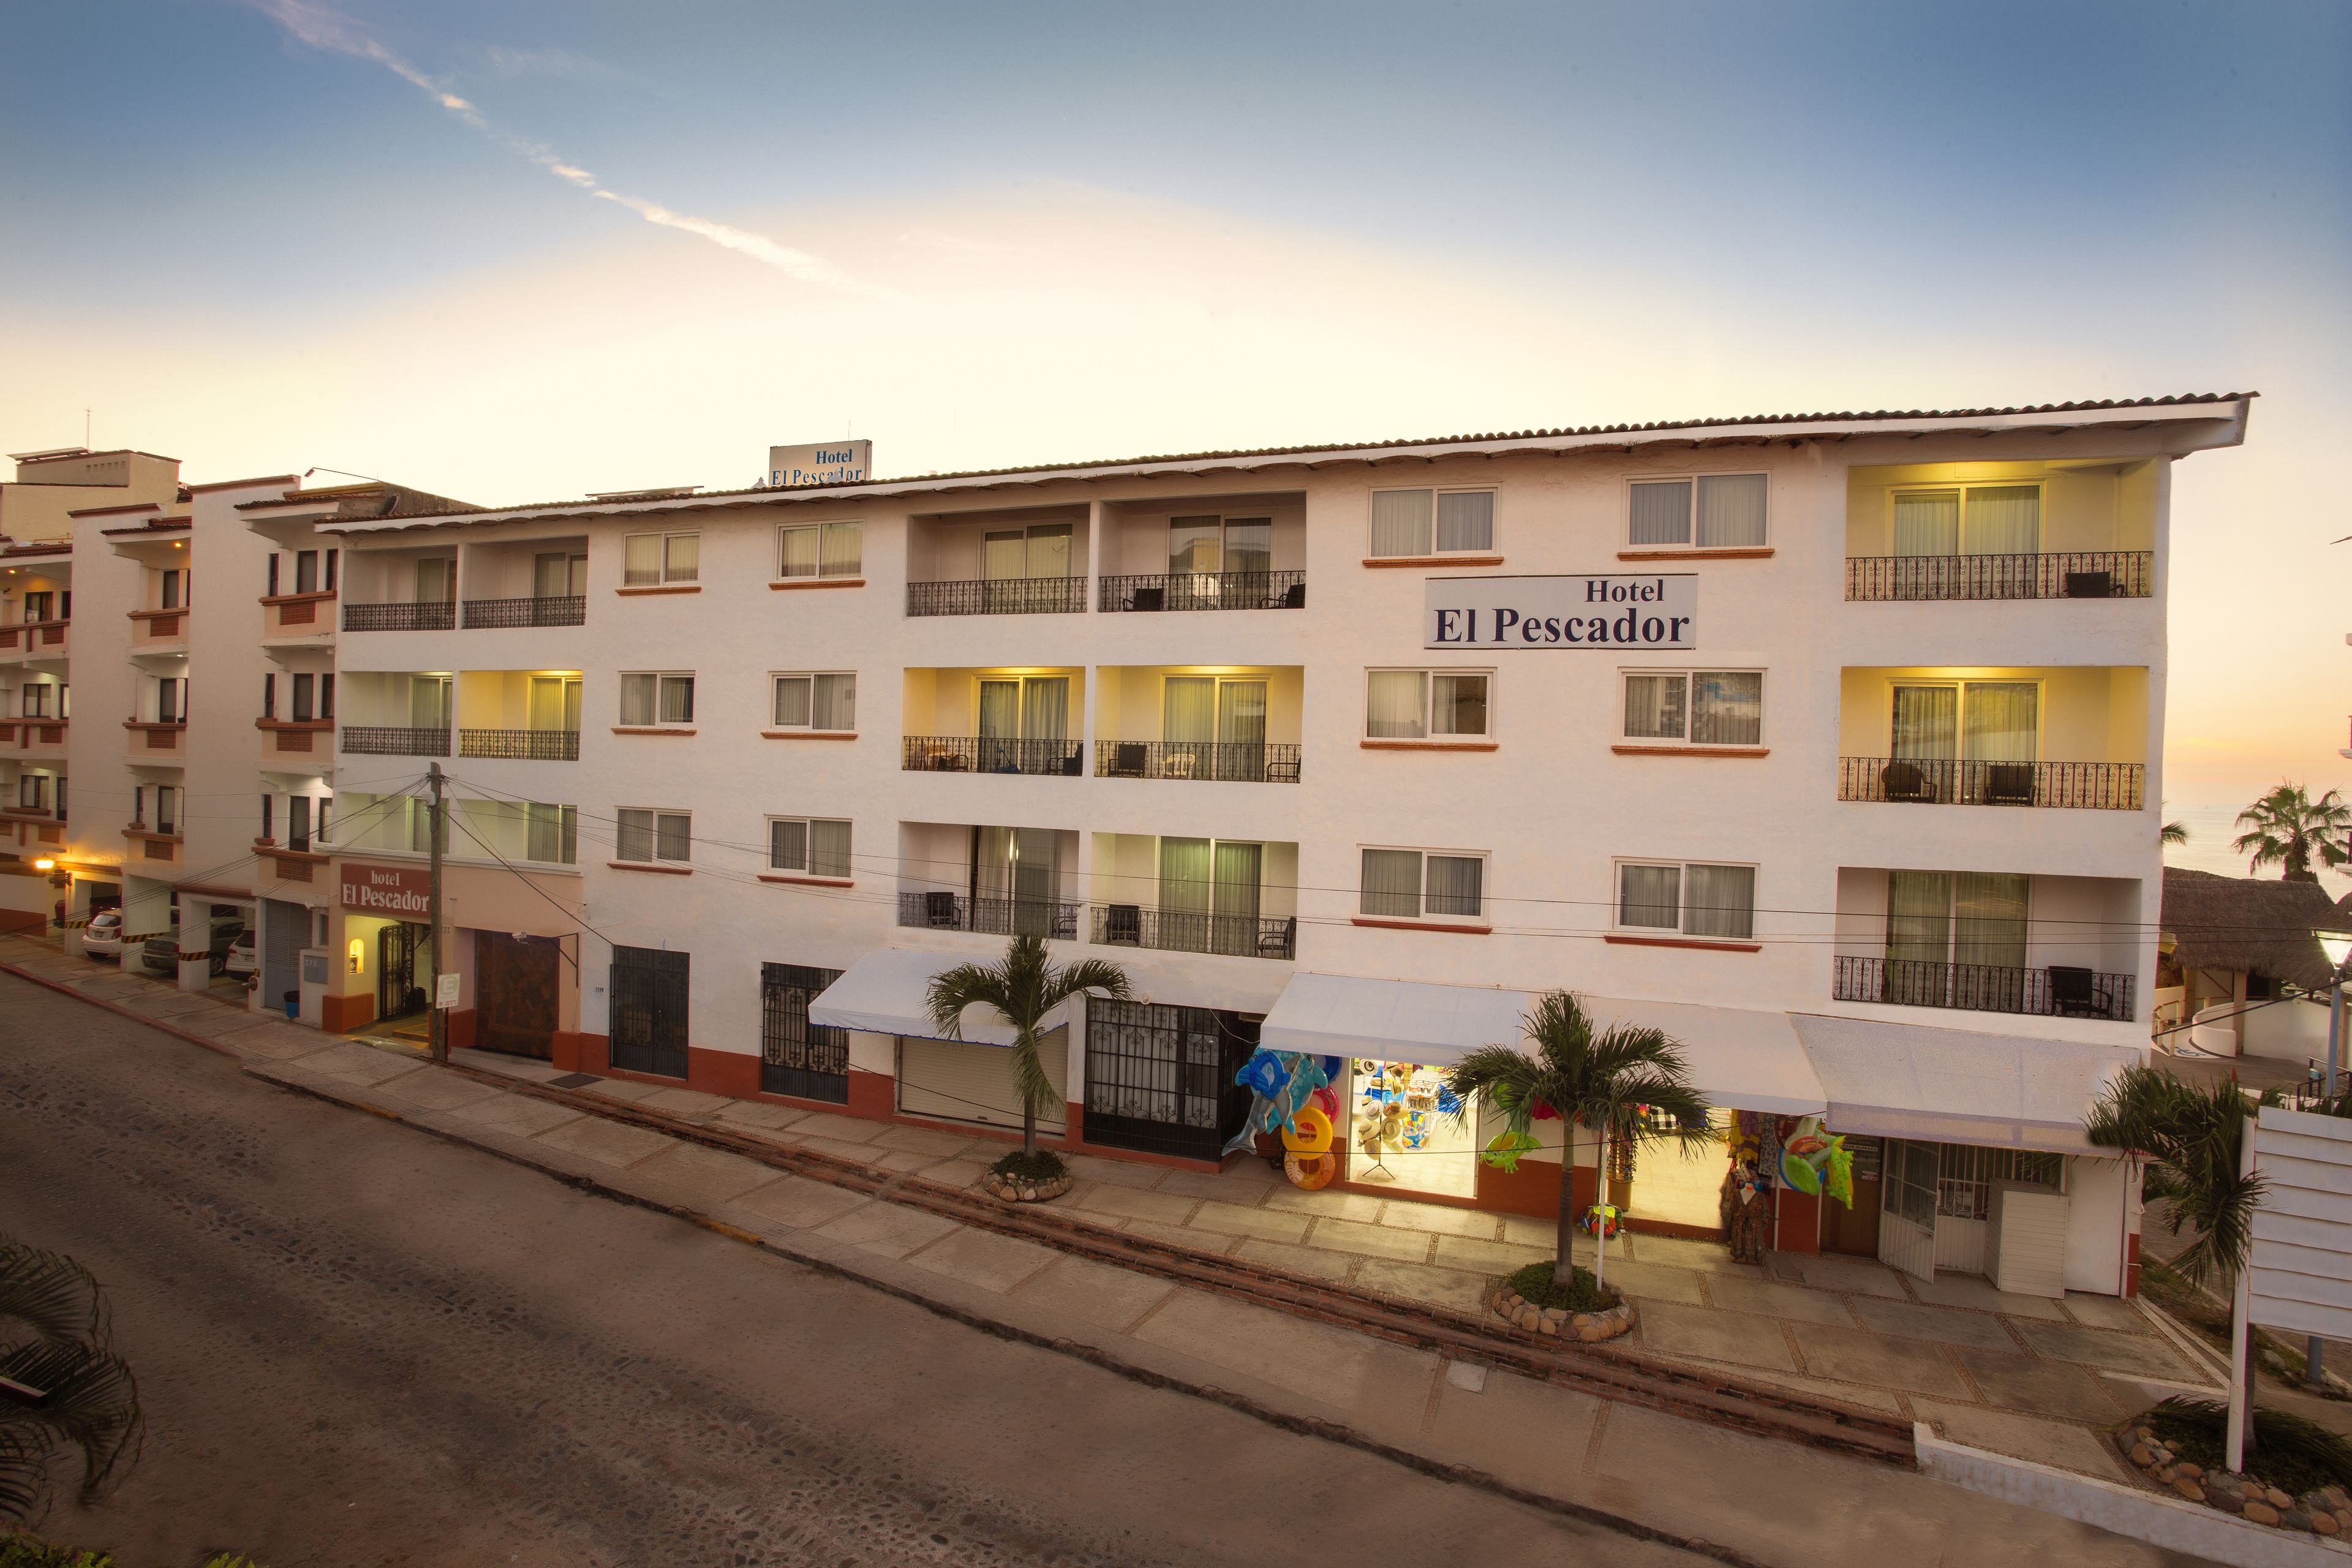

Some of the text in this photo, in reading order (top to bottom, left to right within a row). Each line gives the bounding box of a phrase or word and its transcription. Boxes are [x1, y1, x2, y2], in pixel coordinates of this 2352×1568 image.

[816, 449, 853, 464] Hotel
[772, 470, 787, 485] El
[1584, 579, 1664, 603] Hotel
[1433, 608, 1690, 643] El Pescador
[371, 870, 400, 886] hotel
[342, 883, 429, 912] El Pescador
